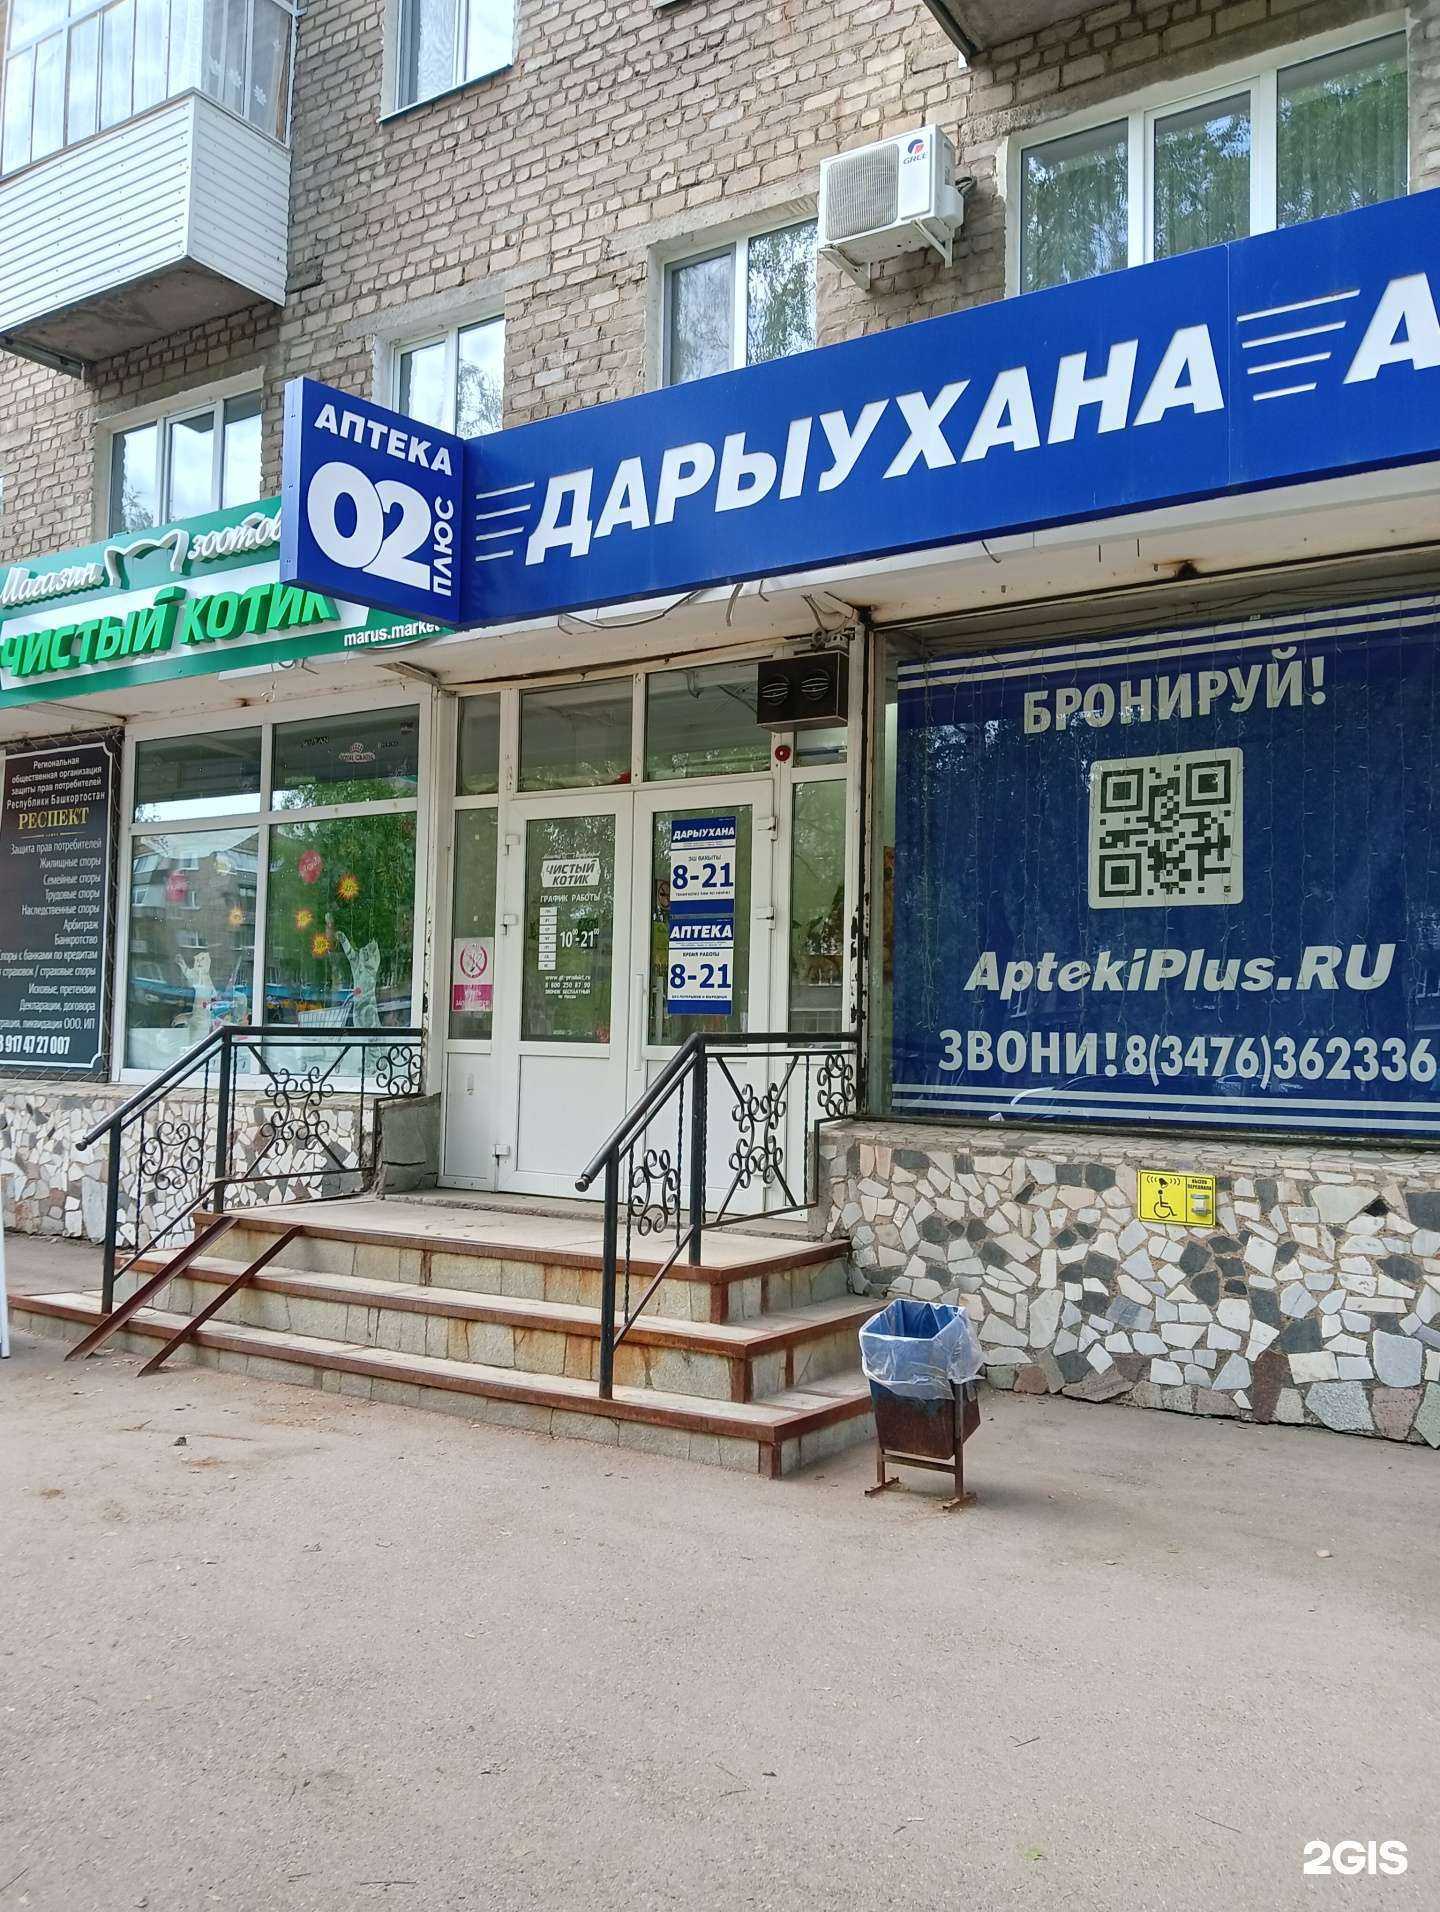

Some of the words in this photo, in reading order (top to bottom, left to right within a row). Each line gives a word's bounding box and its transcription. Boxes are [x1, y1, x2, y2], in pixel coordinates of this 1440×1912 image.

[314, 403, 453, 477] АПТЕКА
[525, 324, 1224, 565] ДАРЫУХАНА
[307, 461, 432, 591] 02
[433, 496, 454, 596] ПЛЮС
[0, 586, 184, 677] ЧИСТЫЙ
[1023, 646, 1327, 734] БРОНИРУЙ!
[33, 757, 80, 770] Региональная
[11, 771, 58, 784] общественная
[59, 766, 102, 779] организация
[11, 786, 36, 796] защиты
[37, 784, 53, 794] прав
[54, 777, 102, 791] потребителей
[7, 797, 50, 810] Республики
[51, 791, 105, 805] Башкортостан
[17, 807, 89, 830] РЕСПЕКТ
[673, 826, 735, 841] ДАРЫУХАНА
[10, 843, 35, 856] Защита
[36, 843, 53, 854] прав
[54, 838, 102, 853] потребителей
[40, 857, 78, 869] Жилищные
[79, 857, 101, 868] споры
[546, 859, 597, 875] ЧИСТЫЙ
[79, 874, 101, 885] споры
[552, 874, 590, 886] КОТИК
[672, 862, 734, 890] 8-21
[78, 889, 100, 901] споры
[571, 892, 600, 902] РАБОТЫ
[21, 904, 76, 916] Наследственные
[78, 904, 100, 916] споры
[63, 918, 99, 932] Арбитраж
[670, 925, 733, 939] АПТЕКА
[54, 933, 98, 947] Банкротство
[670, 963, 732, 989] 8-21
[963, 943, 1396, 1000] AptekiPlus.RU
[83, 1017, 95, 1029] ИП
[5, 1035, 23, 1053] 917
[23, 1035, 36, 1053] 47
[36, 1035, 49, 1054] 27
[50, 1036, 71, 1055] 007
